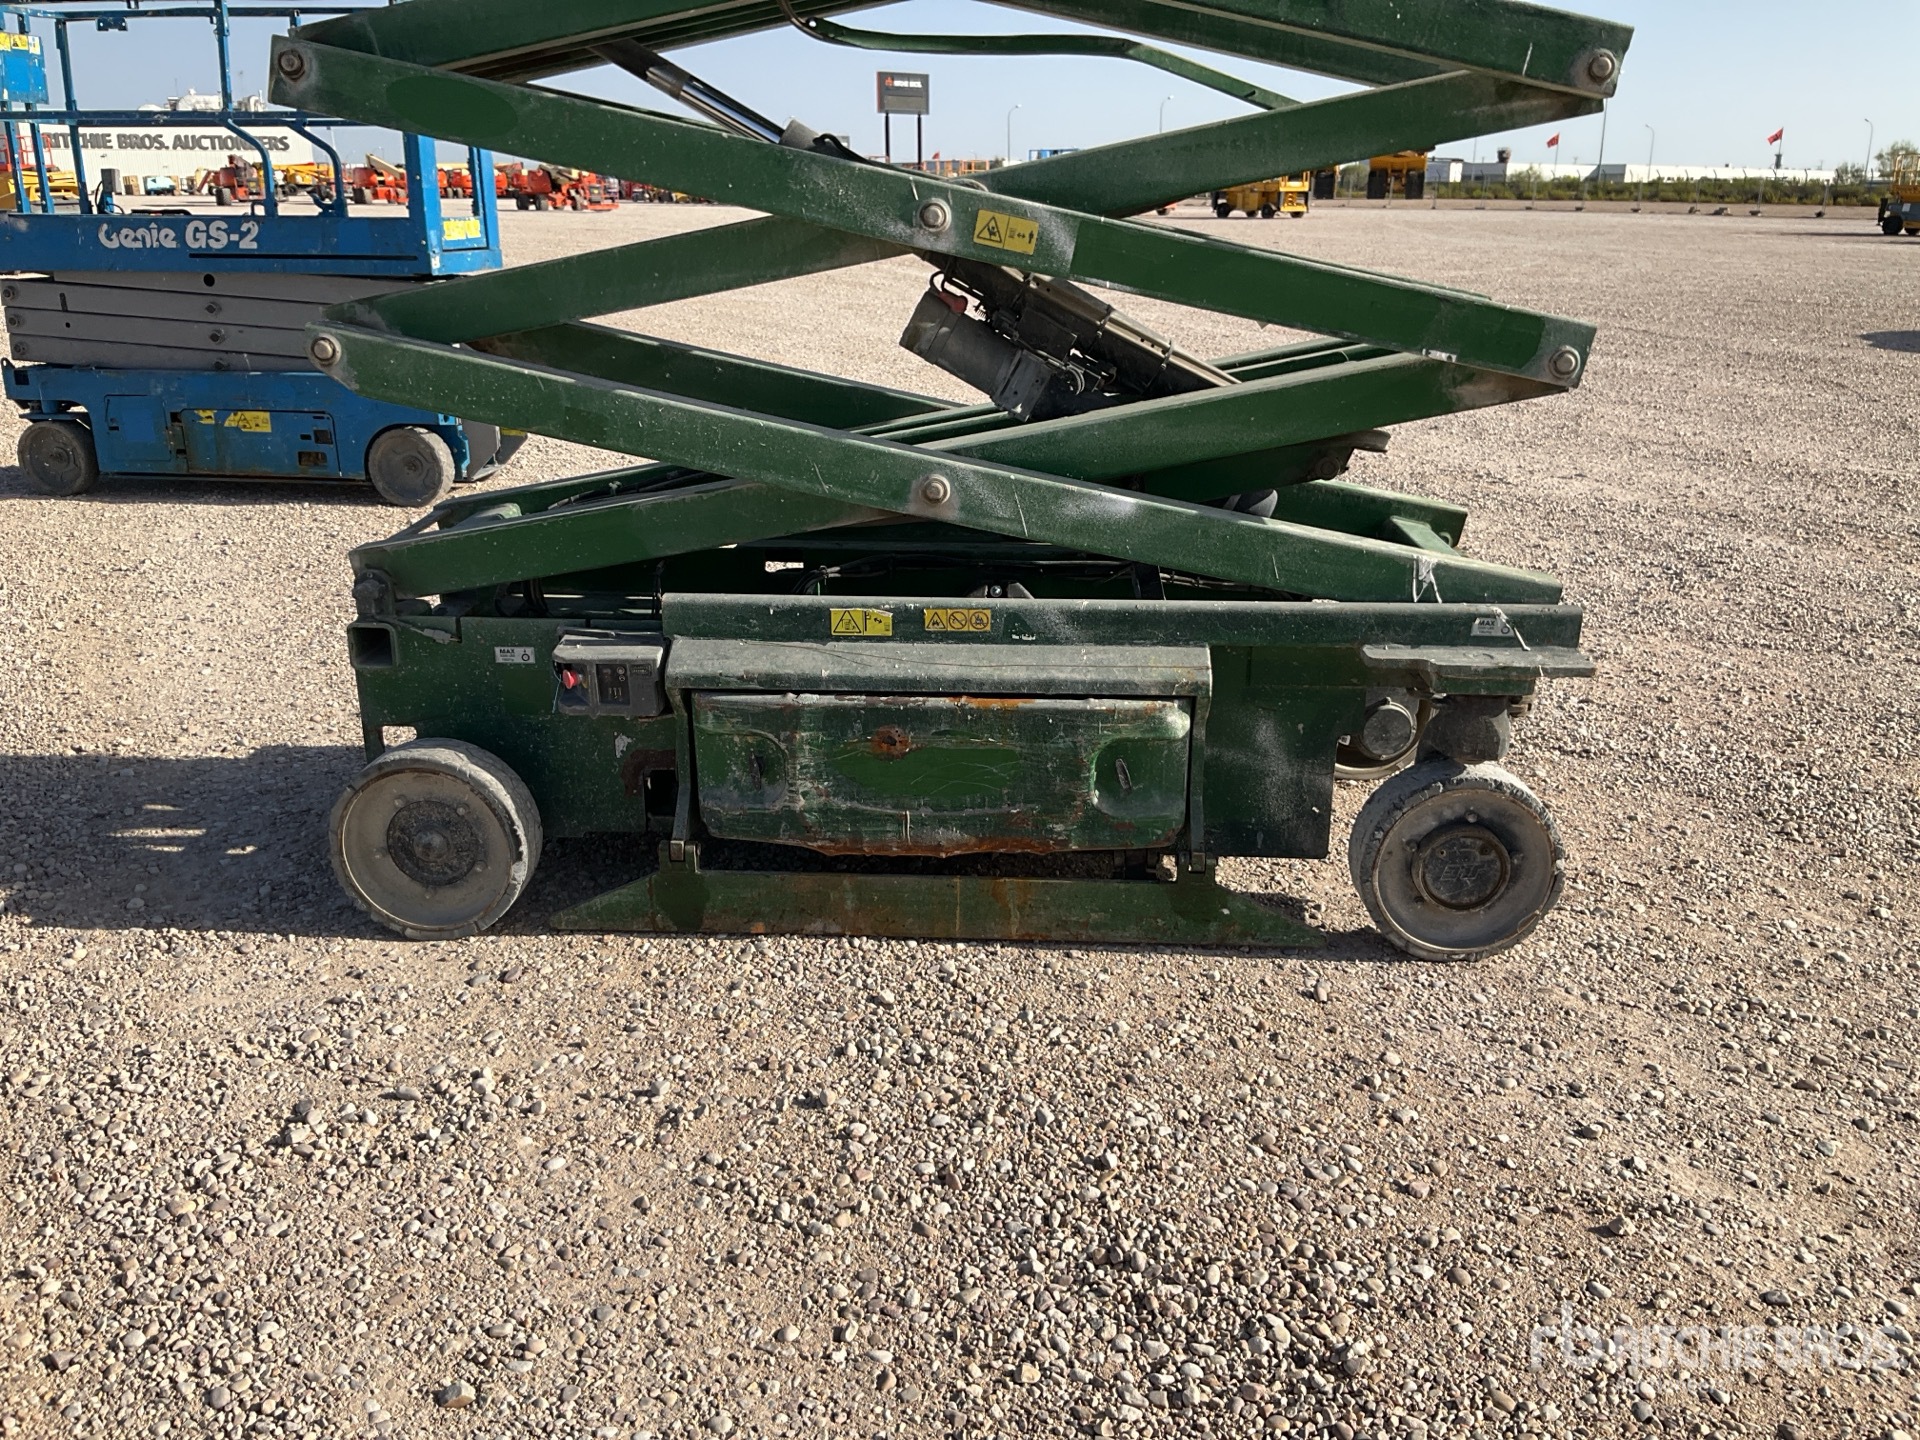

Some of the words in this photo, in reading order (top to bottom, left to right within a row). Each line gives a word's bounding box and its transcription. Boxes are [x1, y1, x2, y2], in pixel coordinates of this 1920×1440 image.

[42, 132, 113, 149] RITHIE
[117, 133, 169, 150] BROS.
[172, 134, 290, 151] AUCTIONERS
[98, 222, 177, 249] Genie
[185, 220, 259, 249] GS-2
